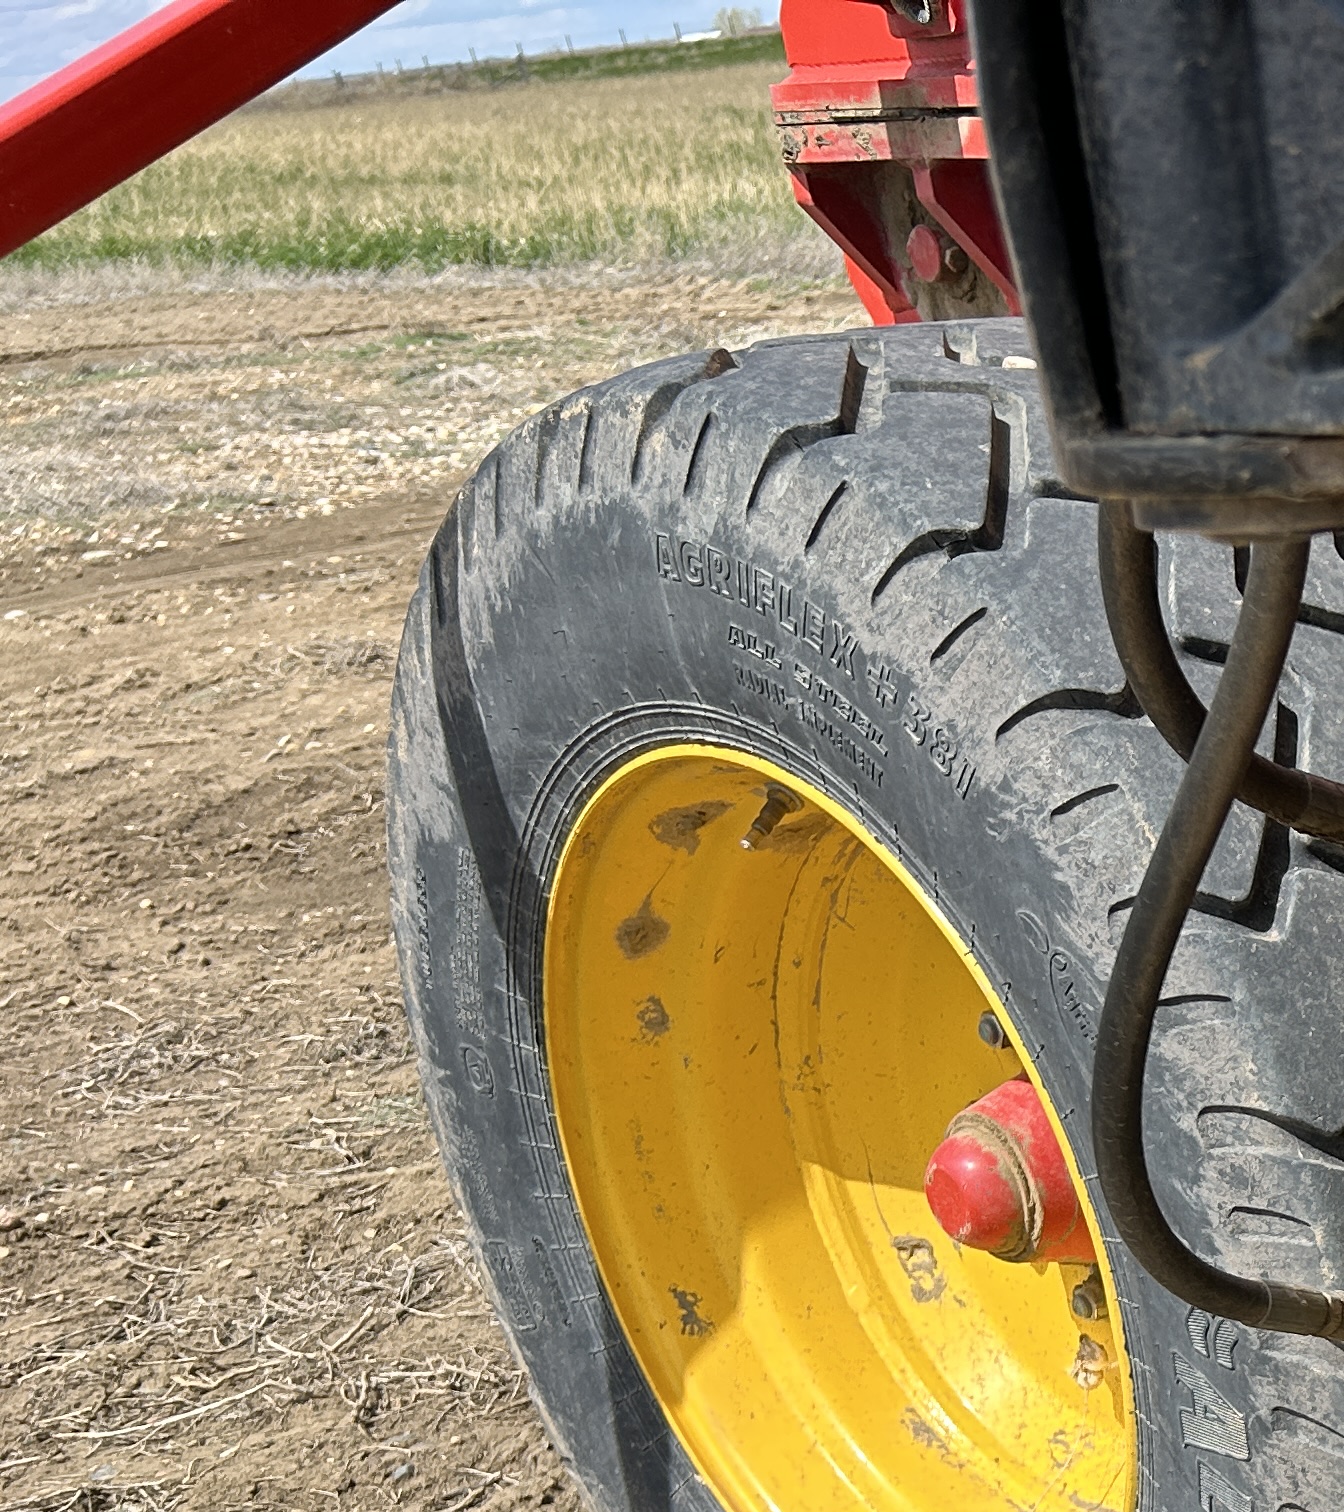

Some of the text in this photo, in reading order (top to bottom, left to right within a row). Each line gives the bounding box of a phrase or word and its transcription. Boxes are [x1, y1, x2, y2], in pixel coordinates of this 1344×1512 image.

[656, 532, 860, 681] AGRIFLEX
[903, 691, 977, 801] 381
[728, 622, 889, 758] ALL STEEL
